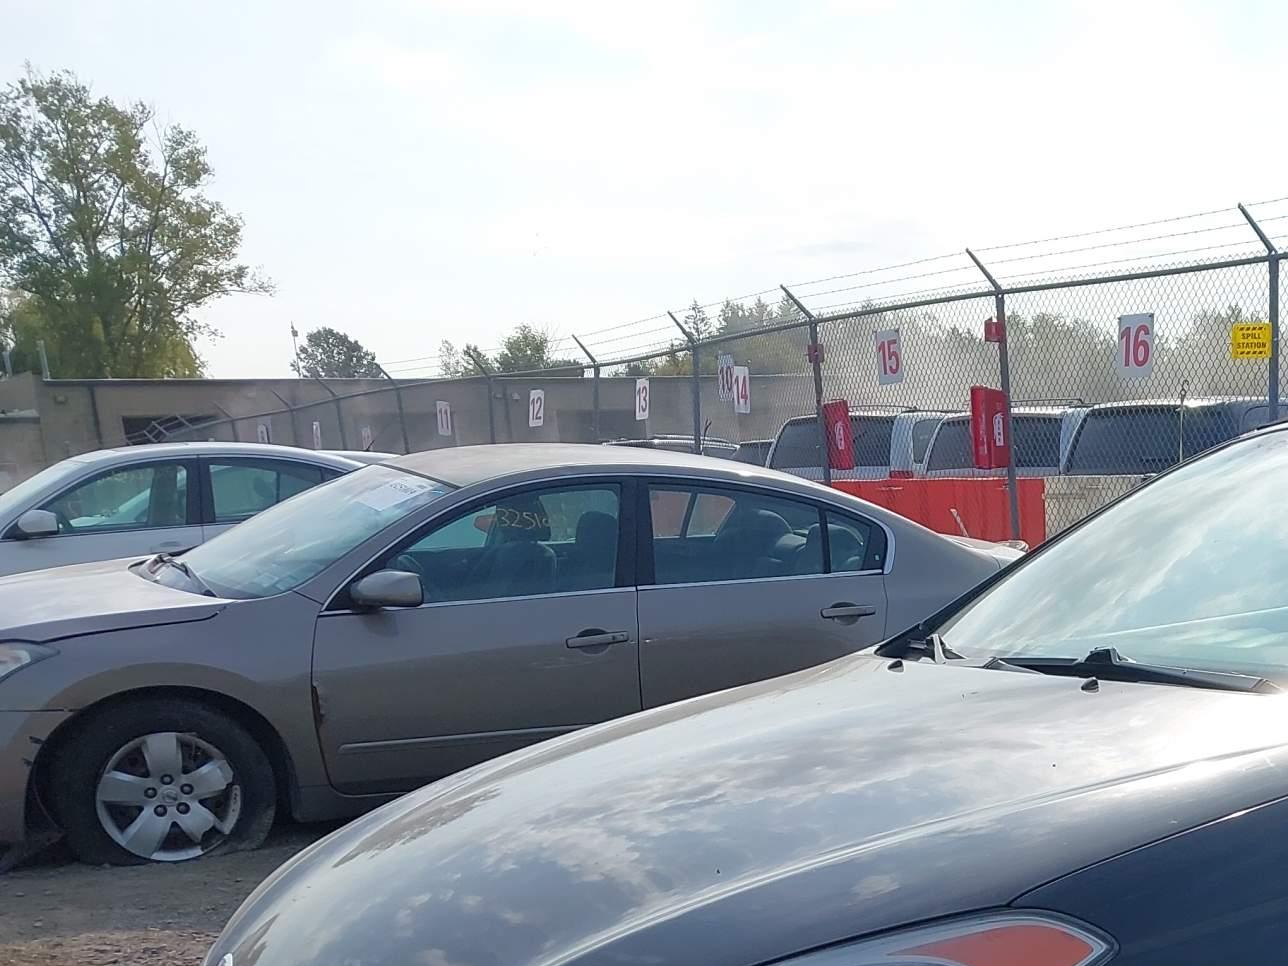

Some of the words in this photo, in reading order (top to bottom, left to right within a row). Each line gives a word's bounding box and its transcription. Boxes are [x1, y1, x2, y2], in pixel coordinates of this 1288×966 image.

[1120, 324, 1150, 367] 16
[1236, 341, 1267, 349] STATION
[1241, 332, 1262, 340] SPILL
[878, 339, 900, 375] 15
[637, 385, 648, 413] 13
[735, 374, 749, 406] 14
[439, 407, 450, 430] 11
[531, 396, 543, 421] 12
